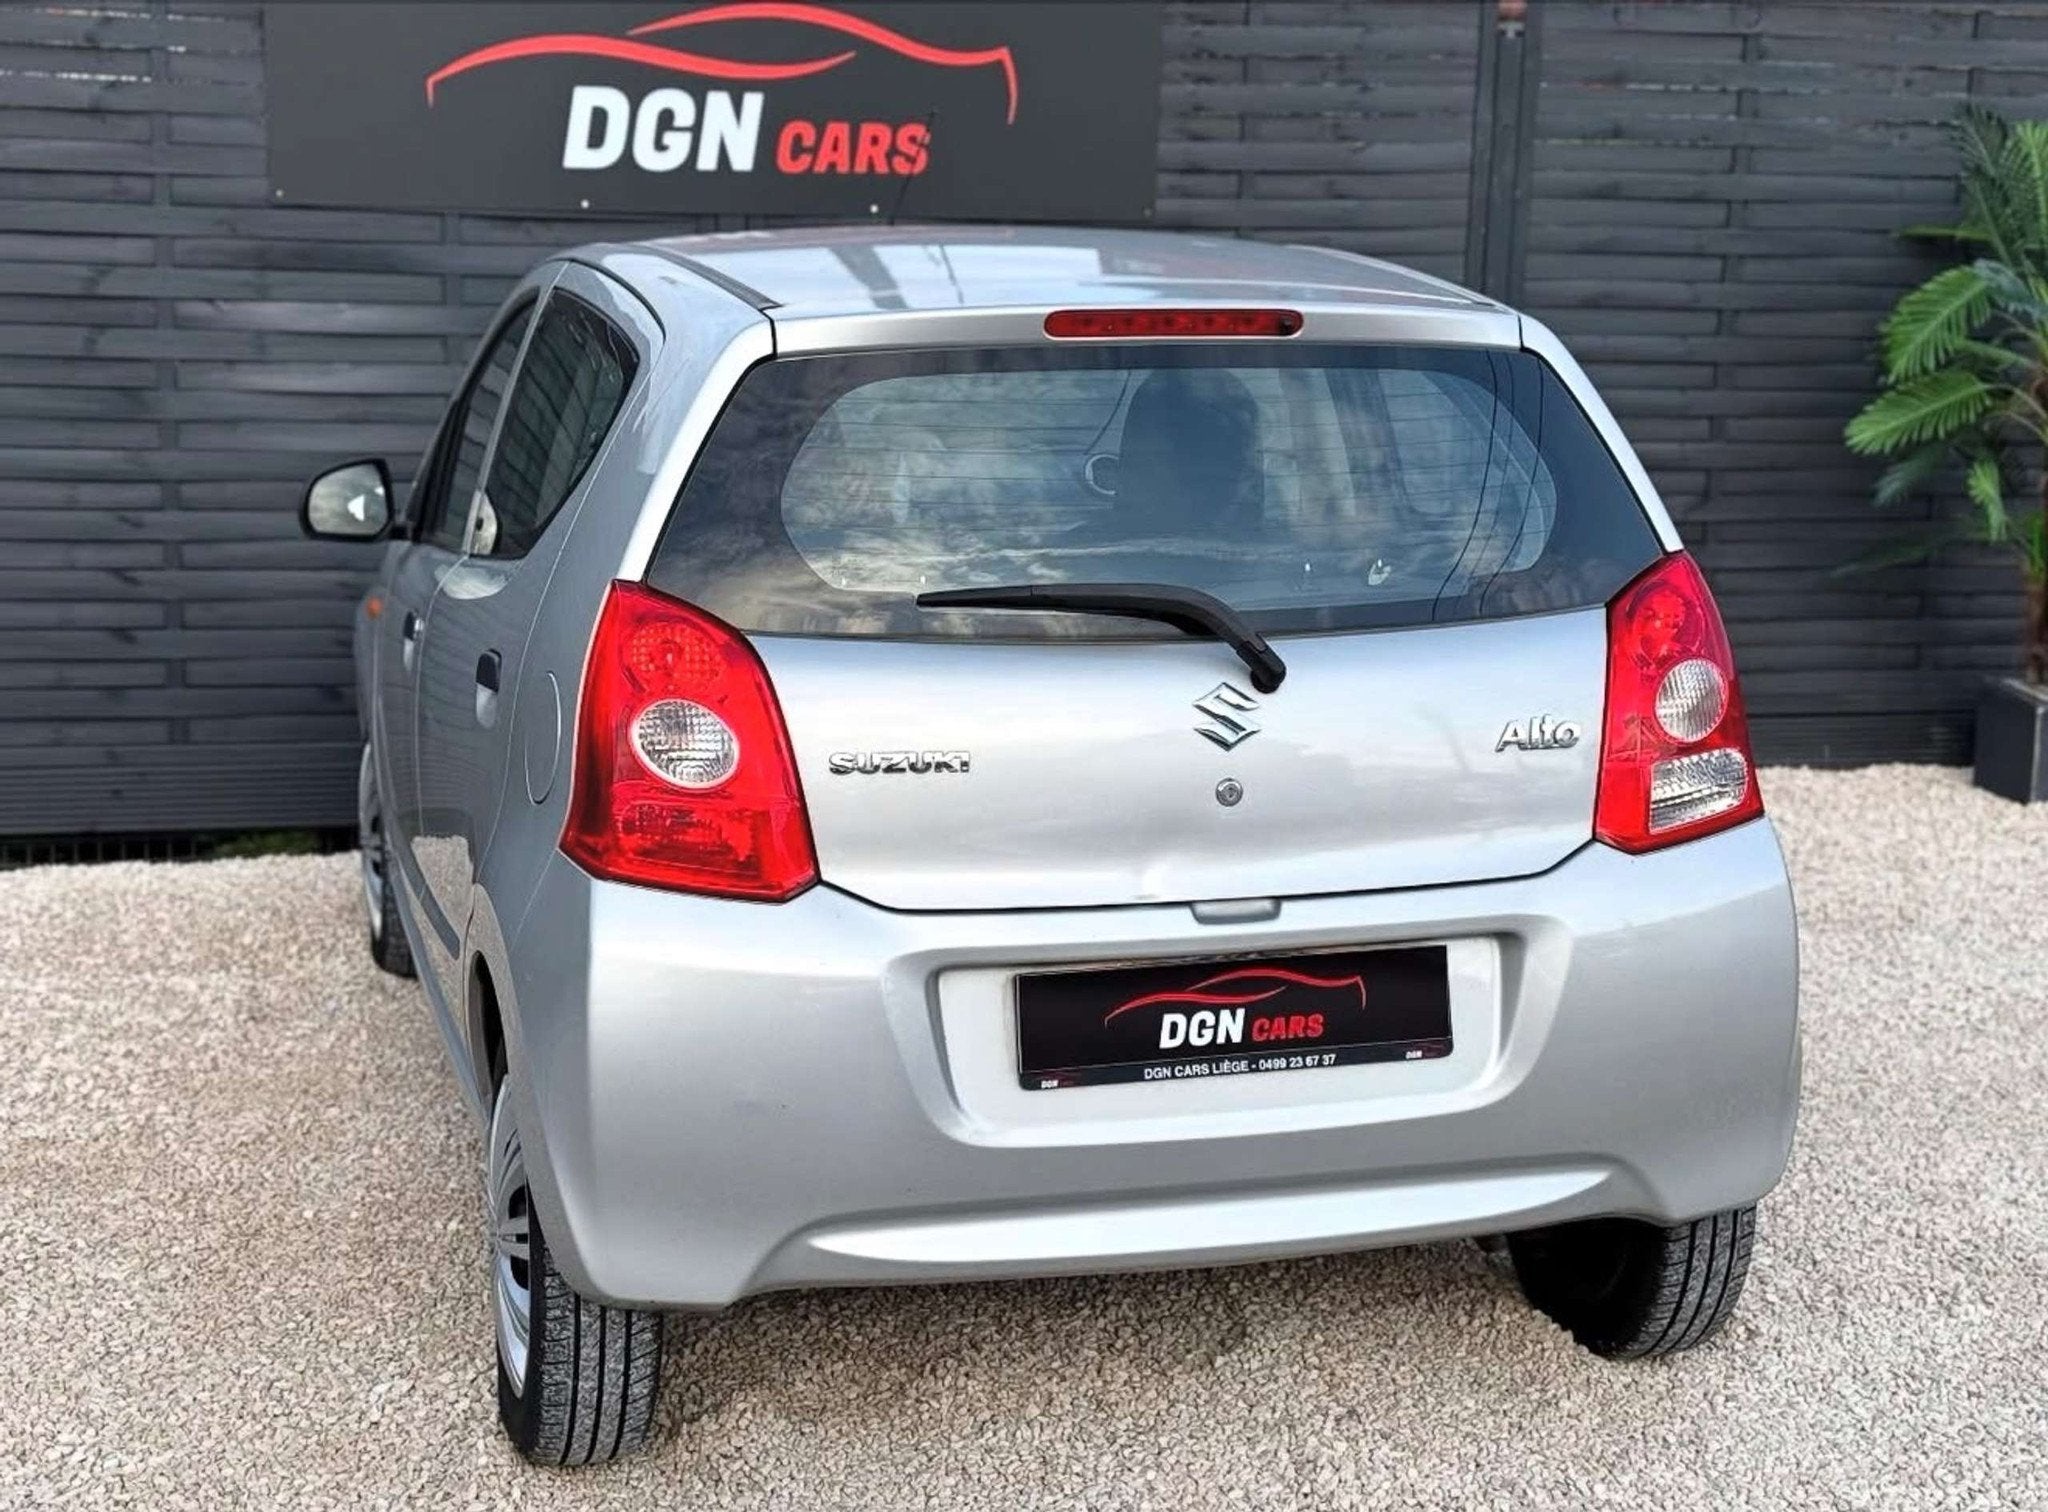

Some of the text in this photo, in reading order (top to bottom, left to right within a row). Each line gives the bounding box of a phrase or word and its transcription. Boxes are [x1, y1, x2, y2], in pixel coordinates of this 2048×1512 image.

[562, 86, 931, 175] DGN CARS
[1496, 713, 1582, 753] Alto
[829, 750, 971, 775] SUZUKI
[1159, 1008, 1324, 1050] DGN CARS
[1144, 1066, 1172, 1080] DGN
[1174, 1063, 1210, 1077] CARS
[1212, 1059, 1250, 1075] LIÈGE
[1258, 1058, 1287, 1071] 0499
[1290, 1057, 1304, 1069] 23
[1322, 1053, 1337, 1066] 37
